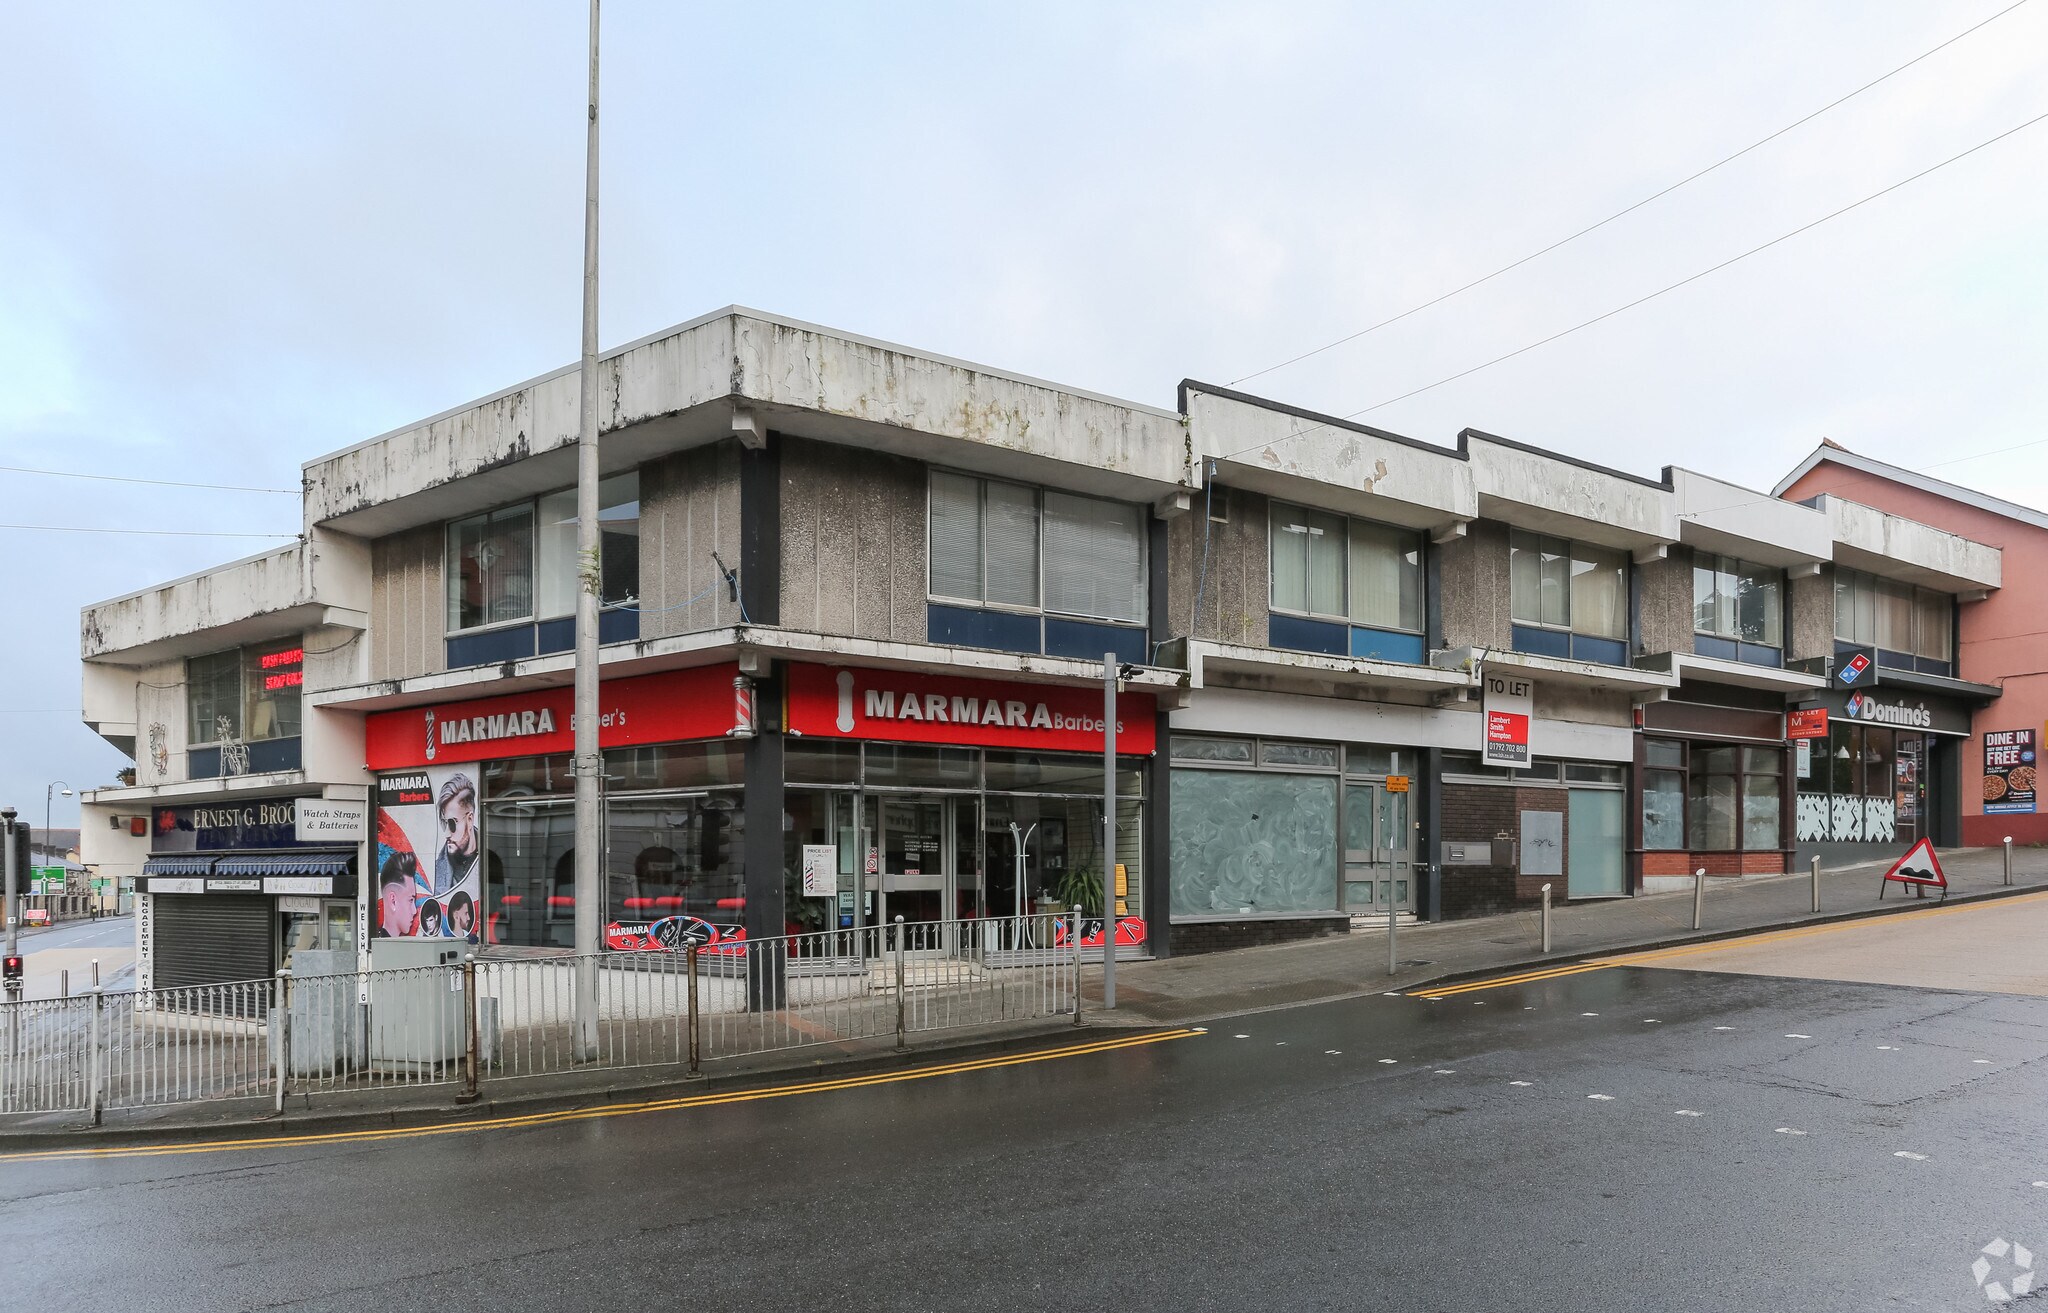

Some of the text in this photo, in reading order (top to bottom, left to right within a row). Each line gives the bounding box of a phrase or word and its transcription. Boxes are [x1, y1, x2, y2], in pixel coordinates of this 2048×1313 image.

[1488, 678, 1530, 697] TO LET
[865, 689, 1124, 733] MARMARA Barbes
[1862, 696, 1931, 727] Domino's
[441, 708, 556, 744] MARMARA
[1489, 723, 1504, 731] Smith
[1490, 715, 1511, 724] Lambert
[1489, 730, 1512, 740] Hampton
[1986, 731, 2029, 746] DINE IN
[1986, 751, 2019, 766] FREE
[380, 775, 430, 791] MARMARA
[399, 791, 430, 803] Barbers
[194, 808, 240, 829] ERNEST
[244, 807, 256, 826] G.
[303, 809, 361, 819] Watch Straps
[306, 819, 359, 830] & Batteries
[141, 895, 149, 959] ENGAGEMENT
[609, 924, 650, 937] MARMARA
